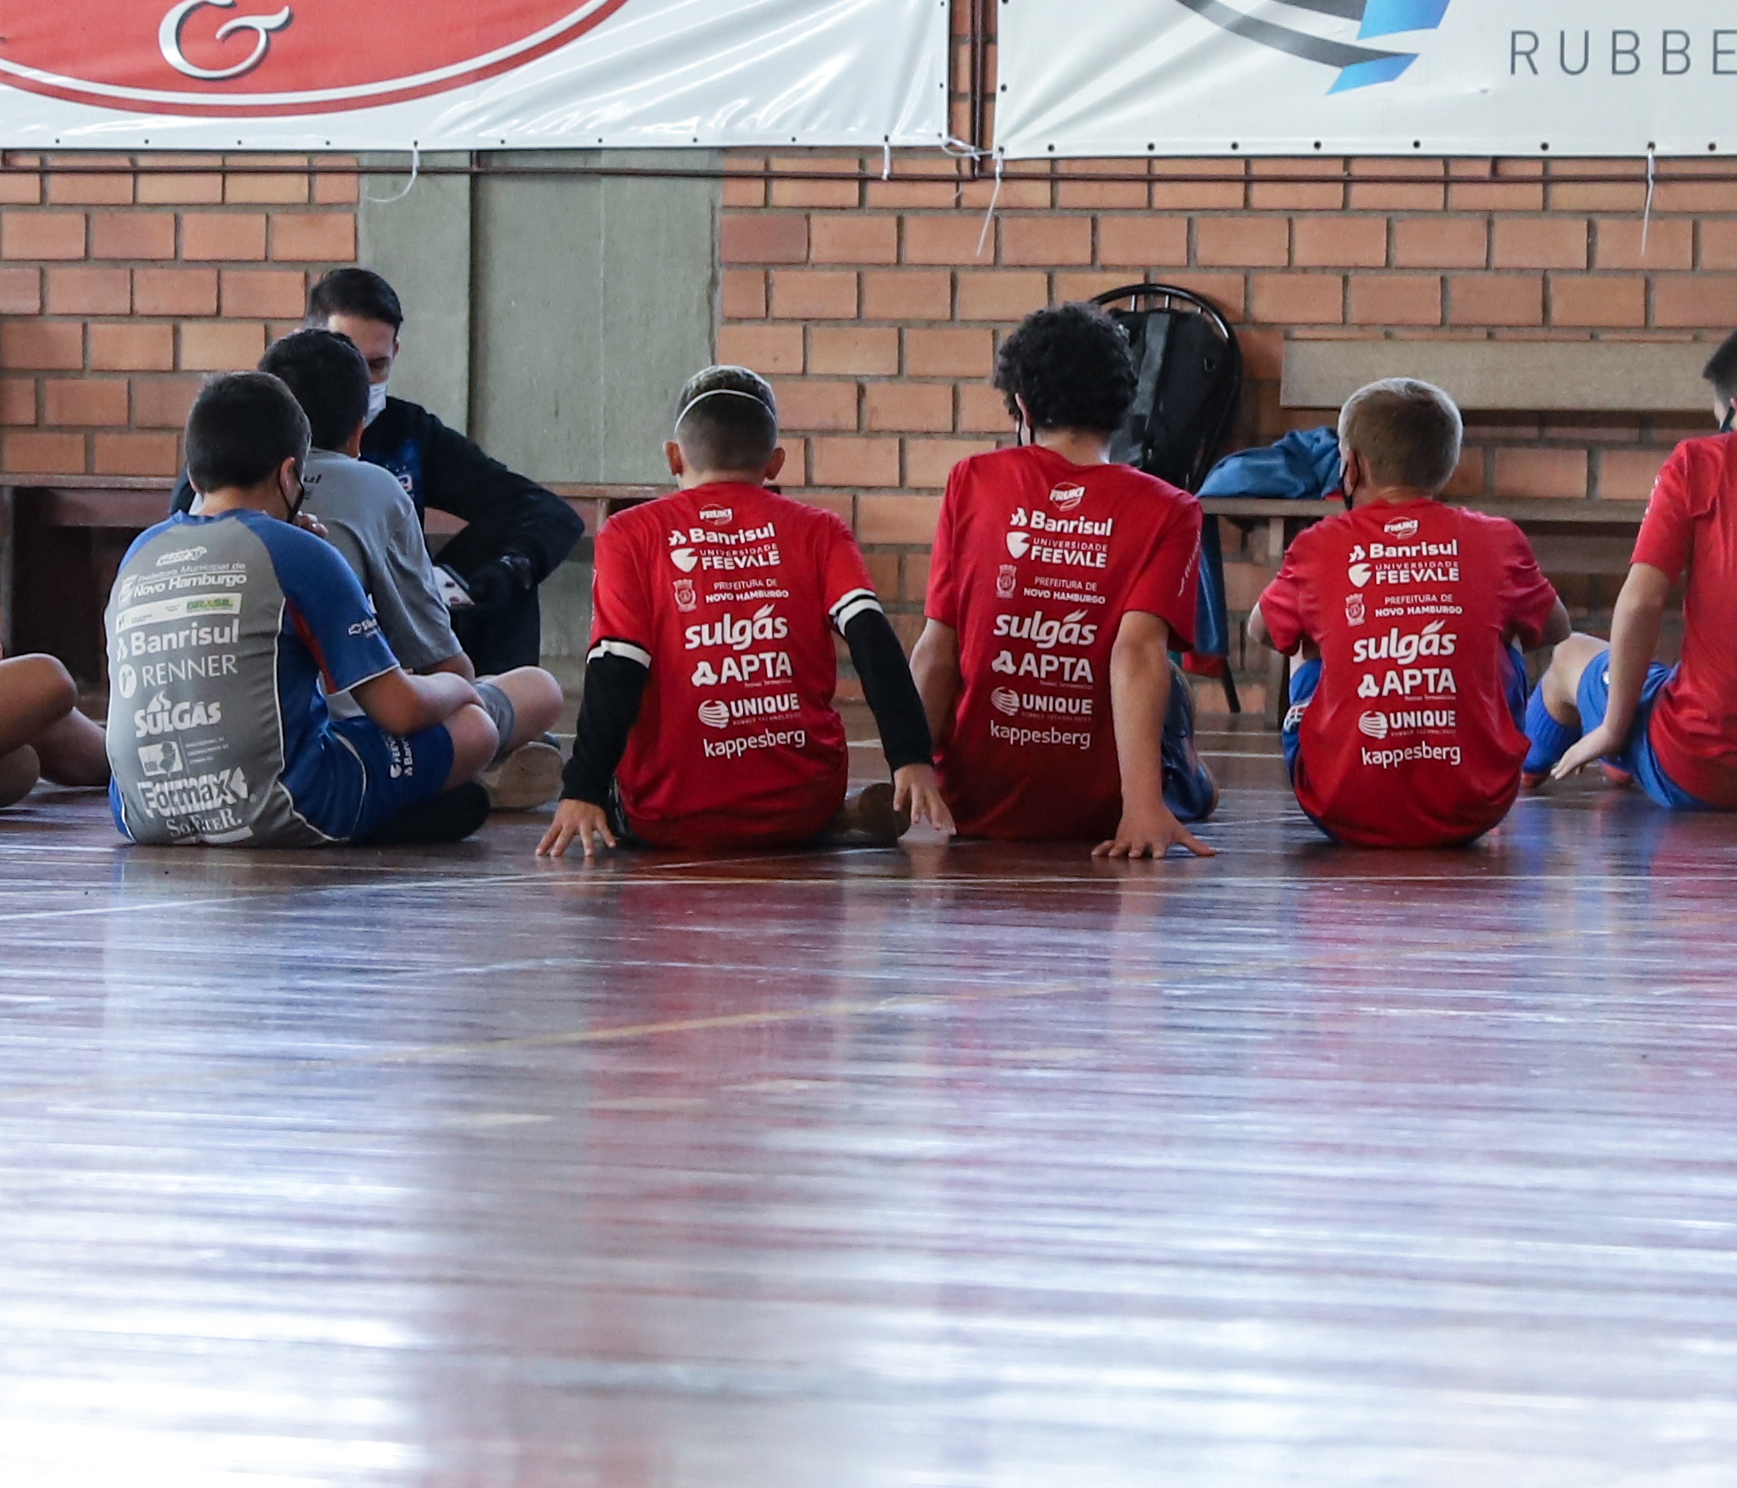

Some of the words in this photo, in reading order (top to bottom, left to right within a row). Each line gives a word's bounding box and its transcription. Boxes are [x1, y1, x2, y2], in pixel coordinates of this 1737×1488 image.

[689, 522, 776, 545] Banrisul
[1030, 510, 1113, 536] Banrisul
[699, 543, 777, 556] UNIVERSIDADE
[1033, 538, 1108, 552] UNIVERSIDADE
[1369, 539, 1458, 558] Banrisul
[701, 550, 780, 570] FEEVALE
[1030, 545, 1107, 568] FEEVALE
[1375, 561, 1458, 570] UNIVERSIDADE
[133, 582, 166, 598] Novo
[169, 573, 247, 590] Hamburgo
[1034, 576, 1083, 590] PREFEITURA
[1085, 582, 1097, 591] DE
[1376, 568, 1459, 584] FEEVALE
[705, 592, 734, 603] NOVO
[1024, 588, 1051, 599] NOVO
[1053, 591, 1106, 604] HAMBURGO
[1385, 595, 1438, 605] PREFEITURA
[1441, 594, 1453, 603] DE
[1375, 608, 1404, 617] NOVO
[1407, 605, 1463, 615] HAMBURGO
[131, 618, 239, 656] Banrisul
[142, 654, 238, 687] RENNER
[720, 651, 793, 684] APTA
[1018, 653, 1094, 683] APTA
[1382, 668, 1457, 696] APTA
[730, 693, 800, 717] UNIQUE
[1022, 694, 1093, 714] UNIQUE
[1390, 710, 1456, 729] UNIQUE
[703, 728, 806, 759] kappesberg
[990, 719, 1091, 750] kappesberg
[1361, 740, 1461, 769] kappesberg
